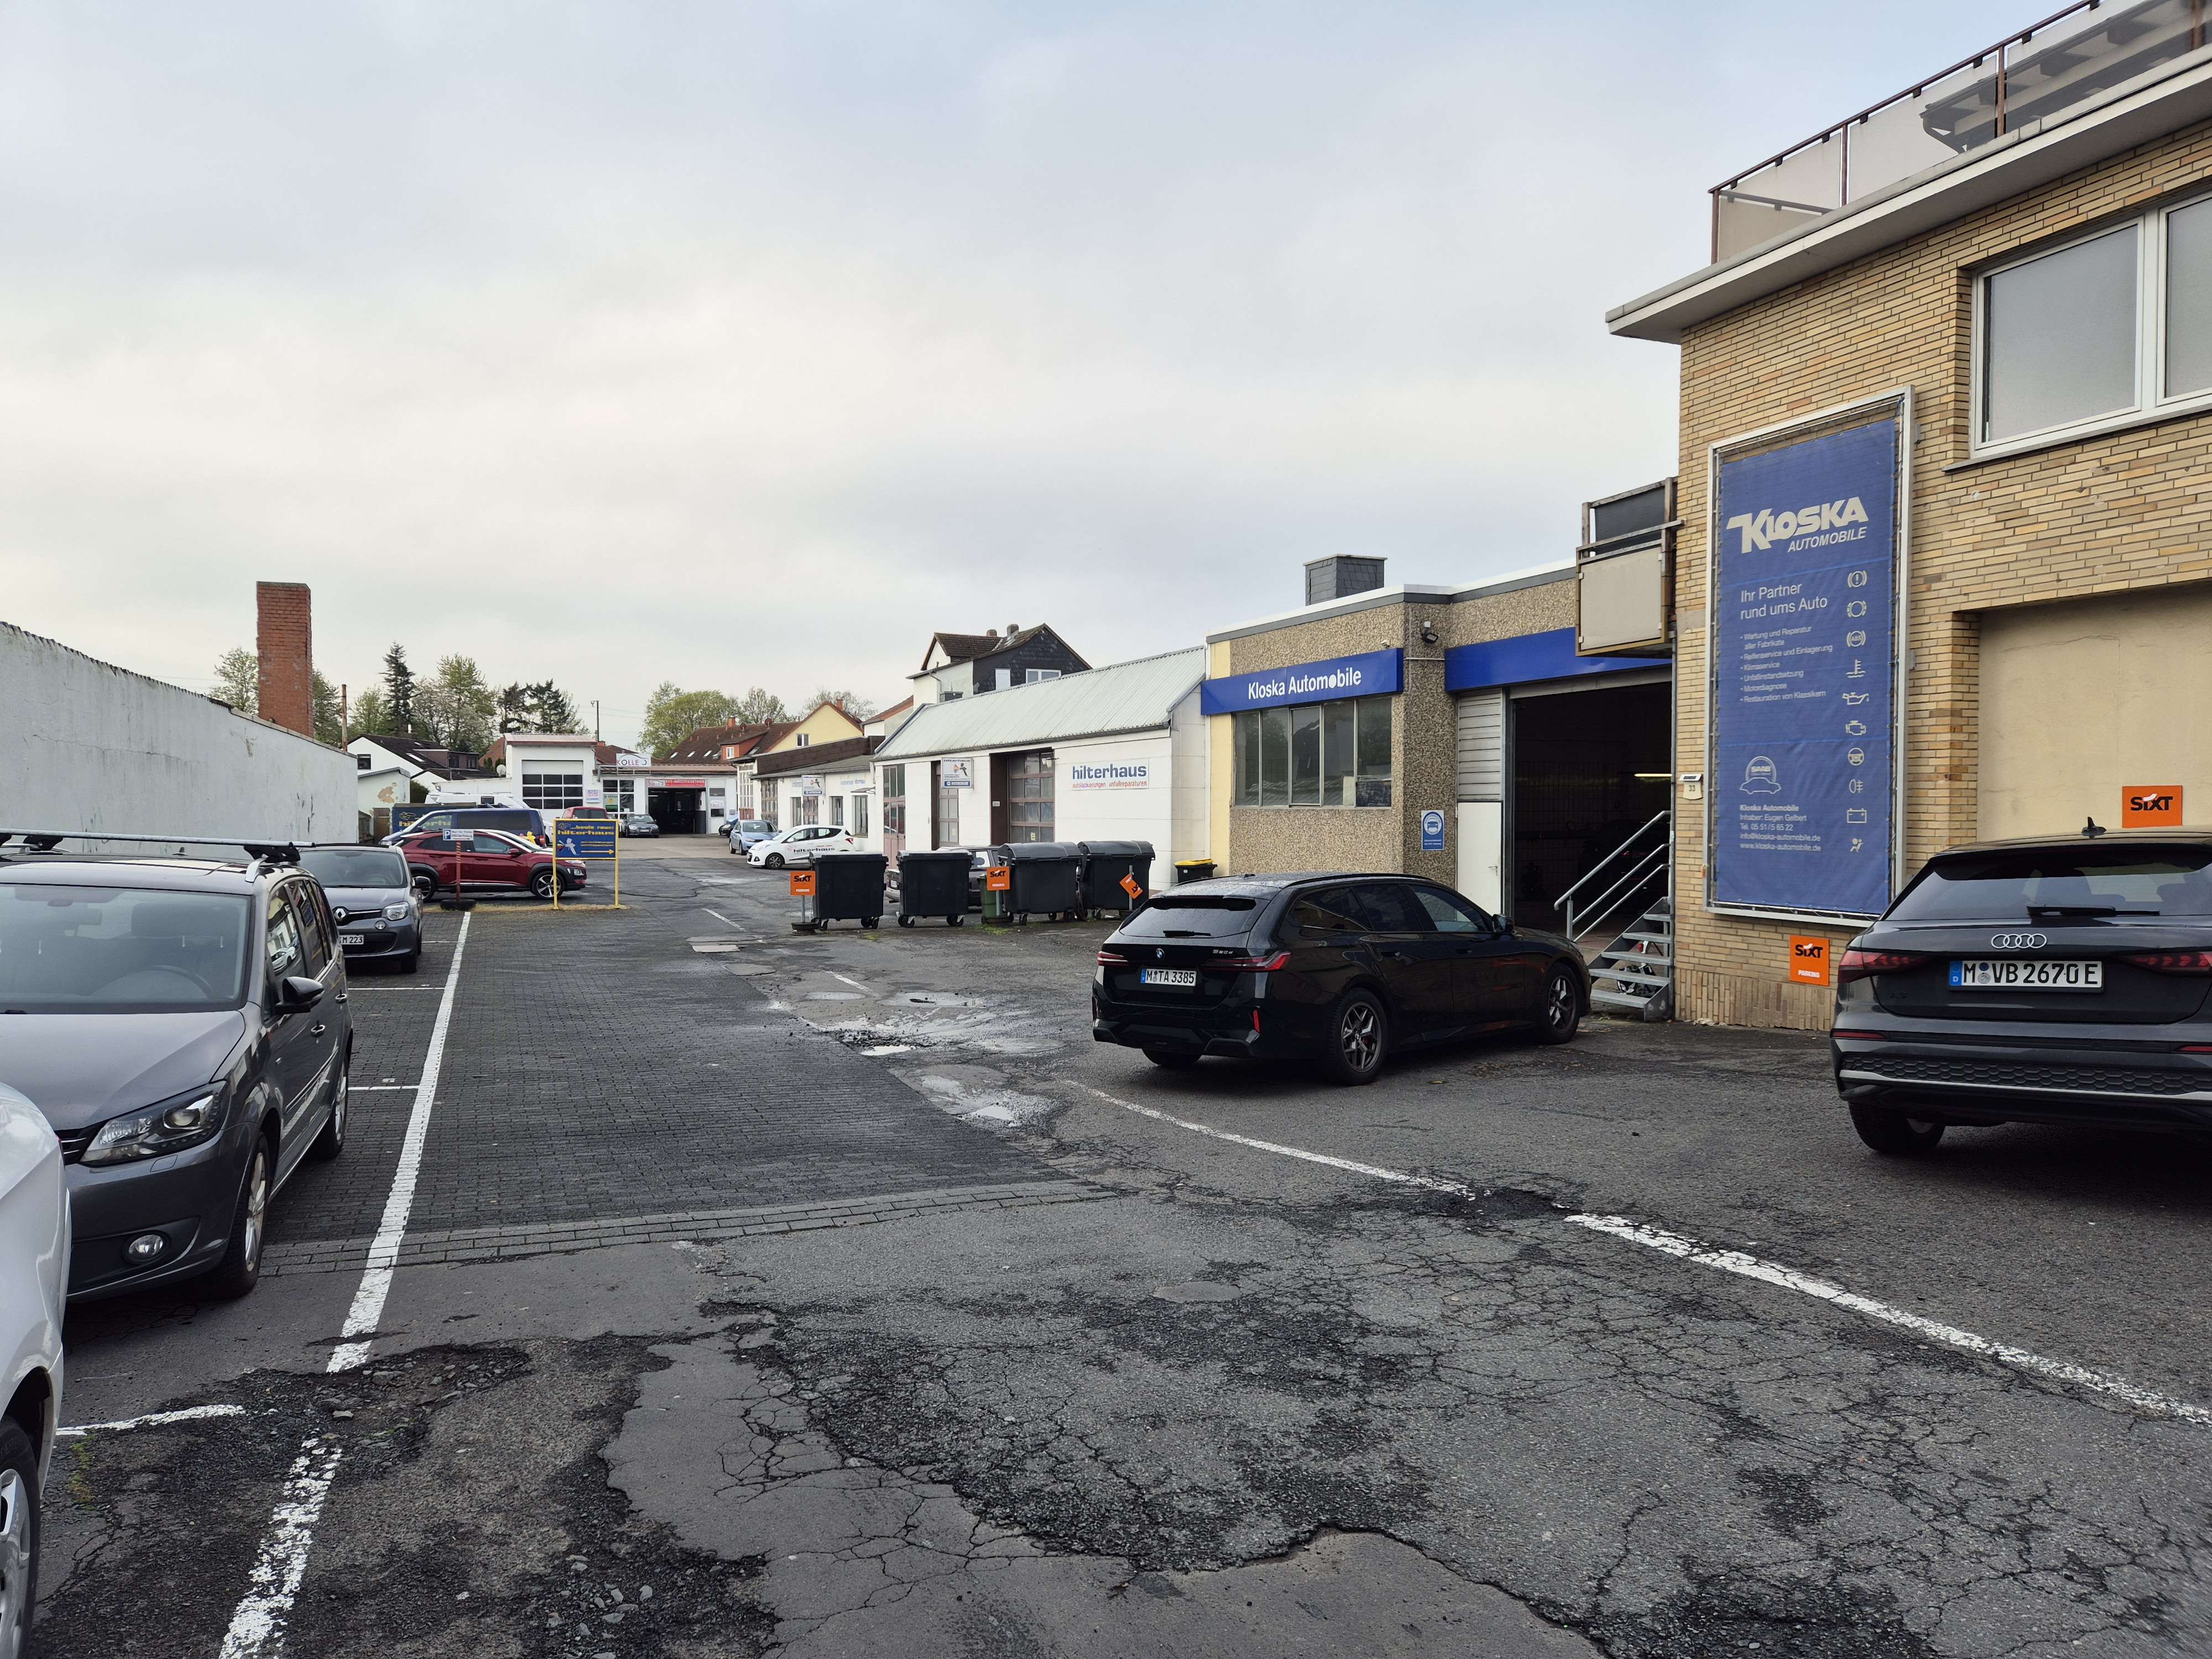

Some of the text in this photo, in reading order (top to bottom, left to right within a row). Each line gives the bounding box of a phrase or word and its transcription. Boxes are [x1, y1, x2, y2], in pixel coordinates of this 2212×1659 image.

[1726, 497, 1869, 554] KLOSKA
[1787, 526, 1867, 552] AUTOMOBILE
[1741, 584, 1803, 603] Ihr Partner
[1740, 596, 1828, 619] rund ums Auto
[1744, 632, 1768, 640] Wartung
[1782, 626, 1812, 636] Reparatur
[1757, 639, 1785, 648] Fabrikate
[1744, 650, 1782, 660] Reifenservice
[1796, 645, 1833, 655] Einlagerung
[1744, 661, 1780, 671] Klimaservice
[1744, 670, 1804, 681] Unfallinstandsetzung
[1248, 667, 1361, 700] Kloska Automobile
[1744, 683, 1787, 692] Motordiagnose
[1744, 693, 1781, 703] Restauration
[1794, 691, 1827, 699] Klassikern
[1072, 764, 1147, 779] hilterhaus
[2130, 794, 2173, 811] SIXT
[445, 830, 450, 839] P
[1740, 832, 1821, 841] info@kloska-automobile.de
[1740, 842, 1822, 851] www.kloska-automobile.de
[1795, 943, 1823, 958] SIXT
[1146, 970, 1152, 981] M
[1159, 971, 1169, 983] TA
[1171, 971, 1195, 984] 3385
[1798, 969, 1820, 978] PARKING
[1964, 963, 1976, 983] M
[1992, 963, 2018, 984] VB
